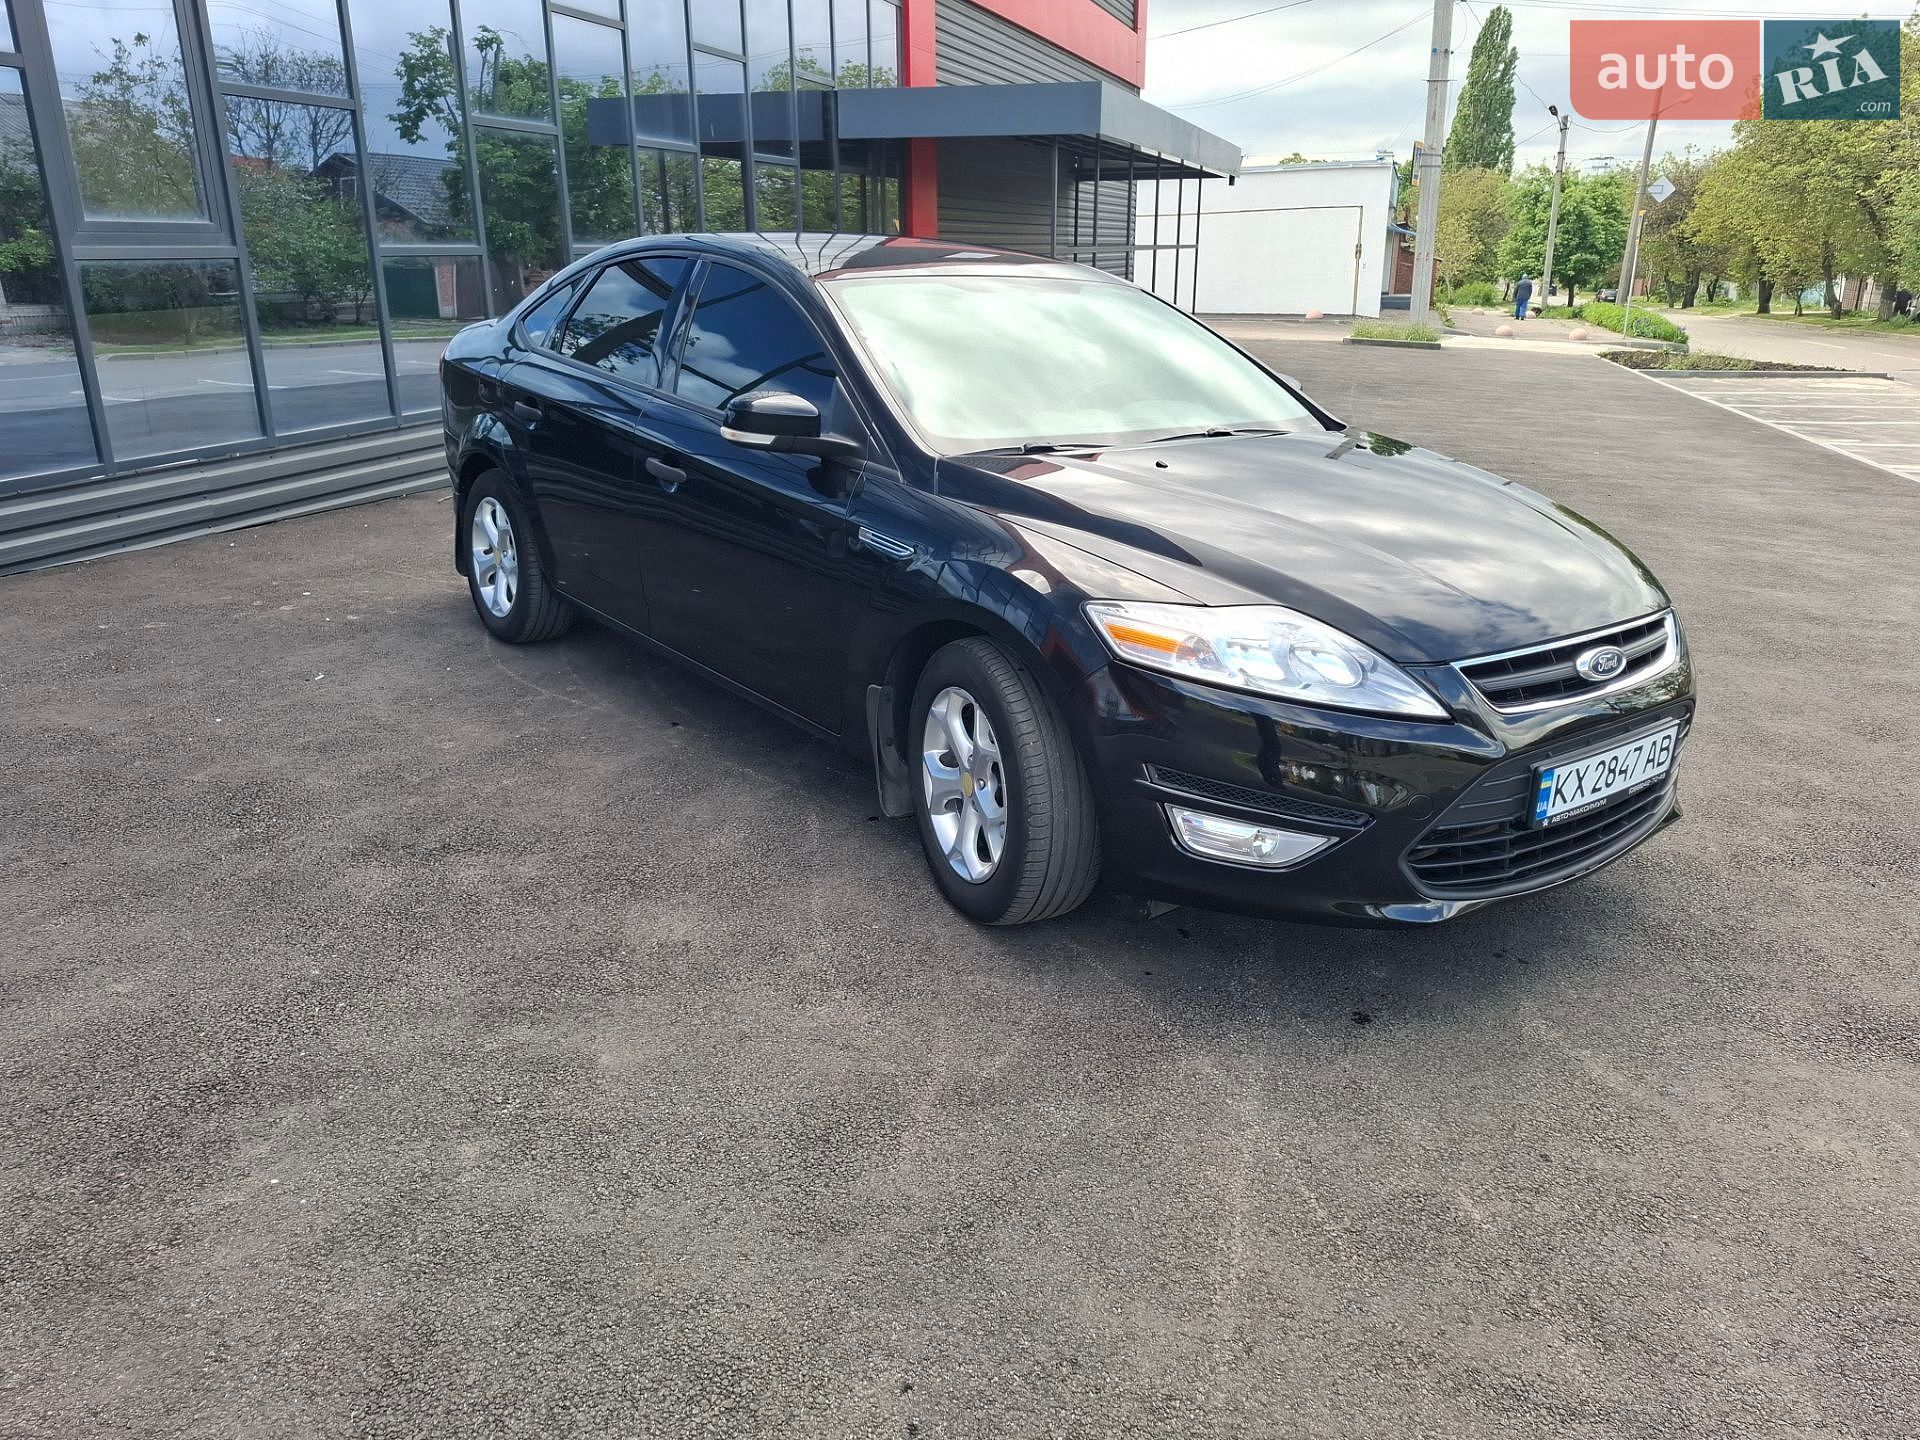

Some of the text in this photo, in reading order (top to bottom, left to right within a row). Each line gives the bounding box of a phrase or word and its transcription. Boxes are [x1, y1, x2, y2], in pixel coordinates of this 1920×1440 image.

[1598, 653, 1619, 672] Ford
[1552, 764, 1591, 808] KX
[1590, 744, 1643, 795] 2847
[1643, 733, 1672, 774] AB
[1536, 800, 1548, 813] UA
